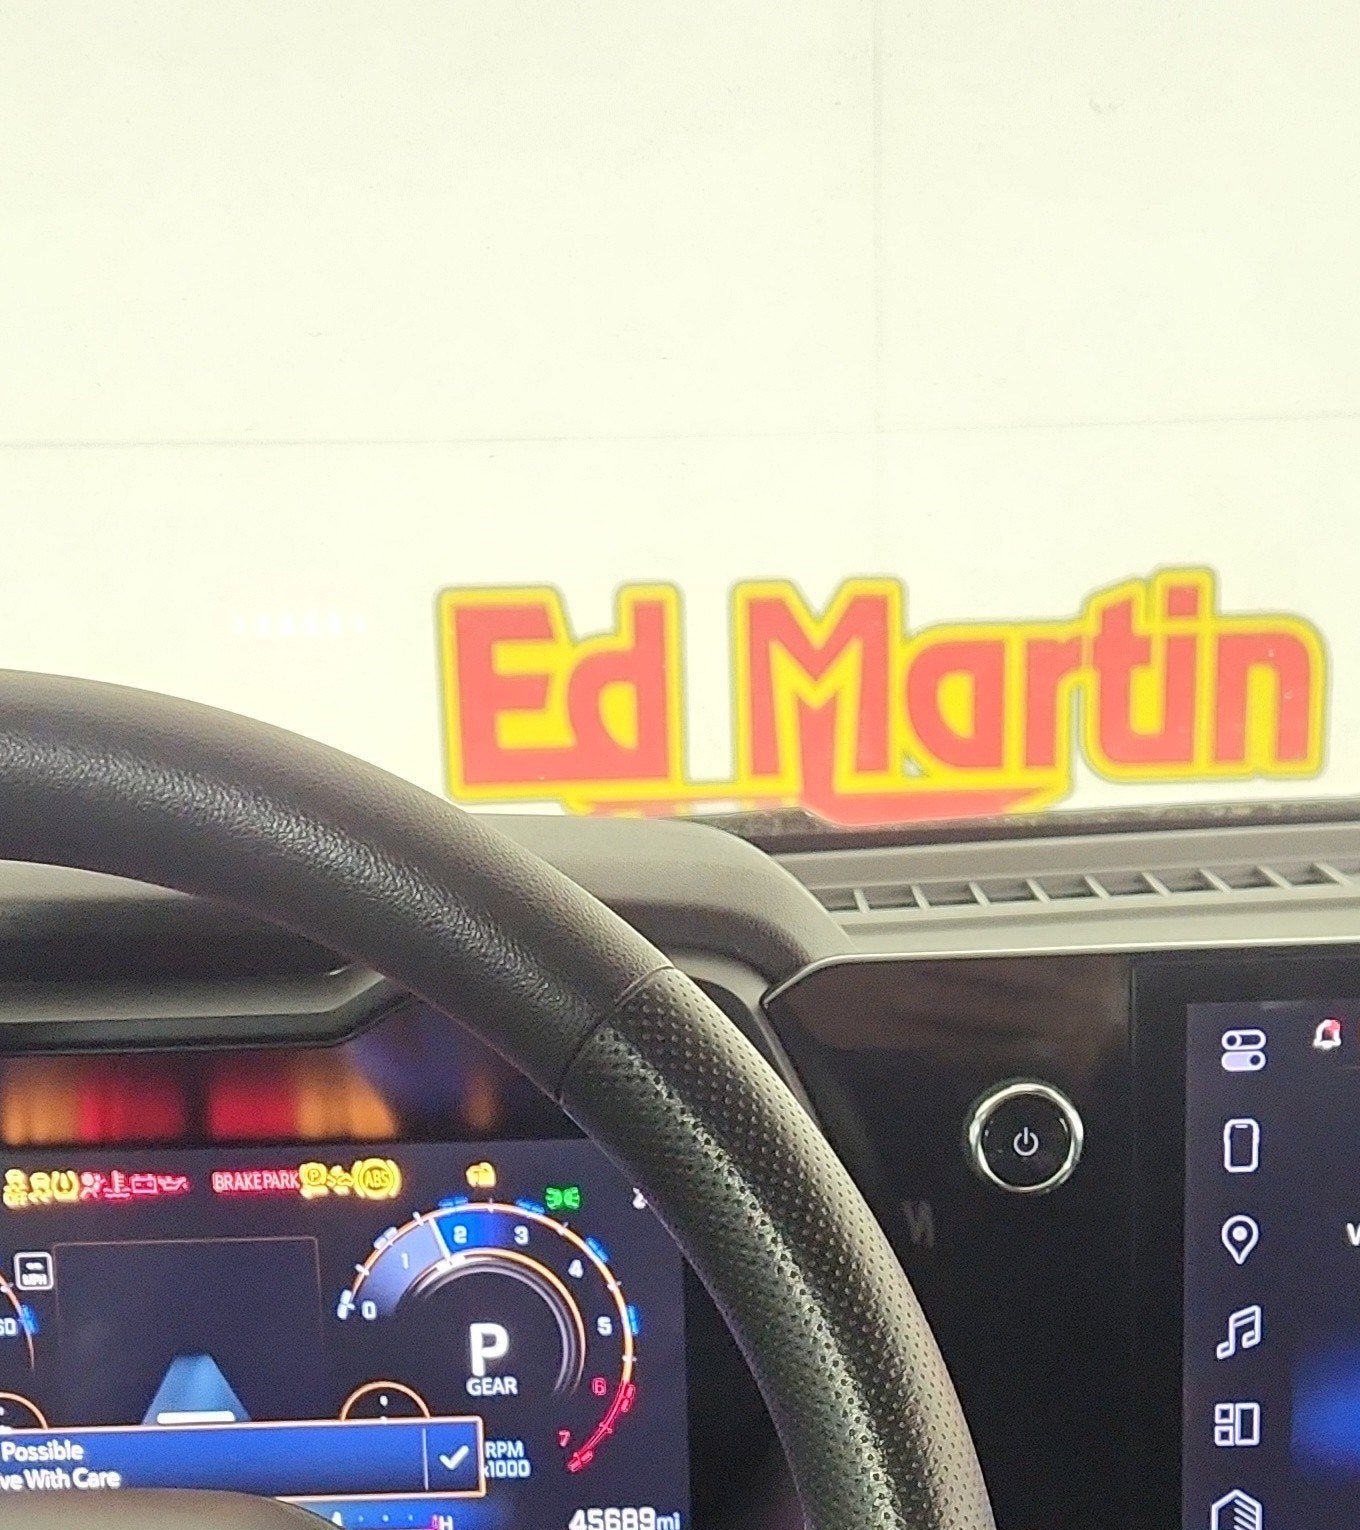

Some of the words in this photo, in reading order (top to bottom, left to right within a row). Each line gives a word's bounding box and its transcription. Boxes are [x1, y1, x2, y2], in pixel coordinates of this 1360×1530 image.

[443, 588, 680, 797] Ed
[732, 568, 1328, 790] Martin
[213, 1172, 262, 1193] BRAKE
[263, 1170, 299, 1190] PARK
[362, 1167, 389, 1188] ABS
[453, 1225, 468, 1244] 2
[514, 1225, 530, 1245] 3
[400, 1252, 411, 1270] 1
[568, 1258, 584, 1279] 4
[361, 1300, 378, 1321] 0
[597, 1316, 613, 1336] 5
[469, 1321, 511, 1377] P
[466, 1376, 518, 1397] GEAR
[592, 1377, 607, 1396] 6
[557, 1429, 572, 1447] 7
[1, 1439, 85, 1462] Possible
[485, 1440, 525, 1459] RPM
[24, 1467, 72, 1491] With
[73, 1467, 122, 1490] Care
